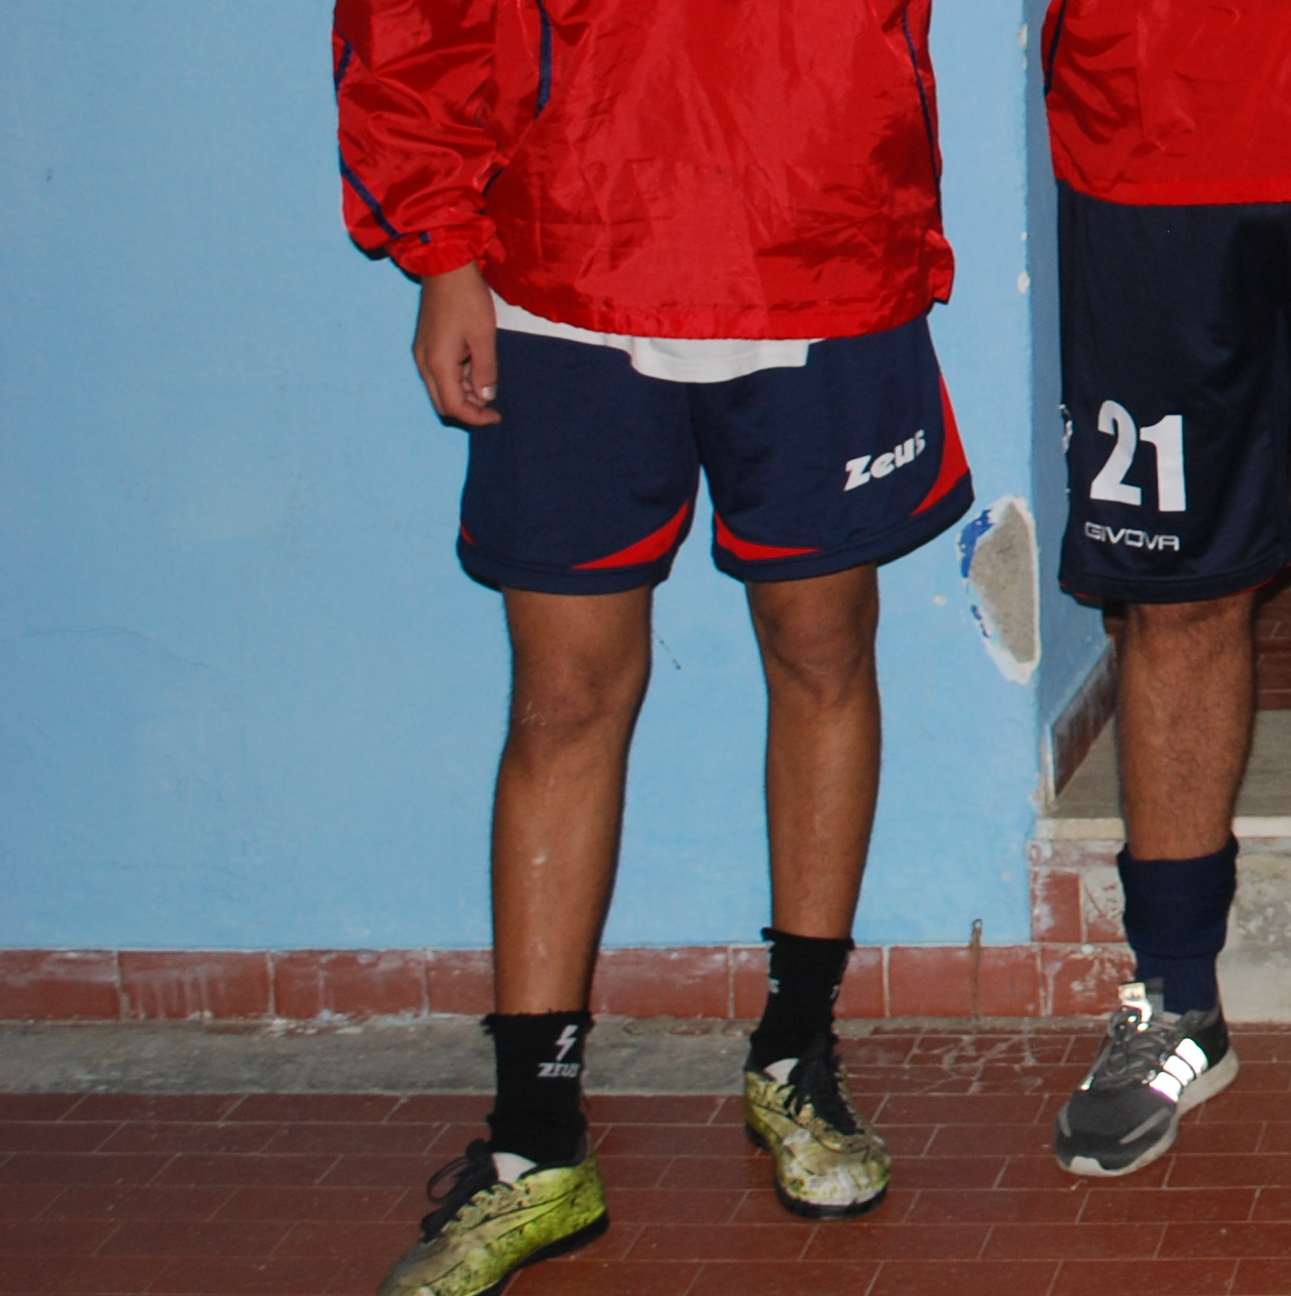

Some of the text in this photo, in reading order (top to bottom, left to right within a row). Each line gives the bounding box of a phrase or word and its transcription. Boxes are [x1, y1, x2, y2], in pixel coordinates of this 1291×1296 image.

[843, 429, 926, 492] Zeus
[1090, 400, 1186, 512] 21
[1084, 521, 1180, 552] GIVOVA
